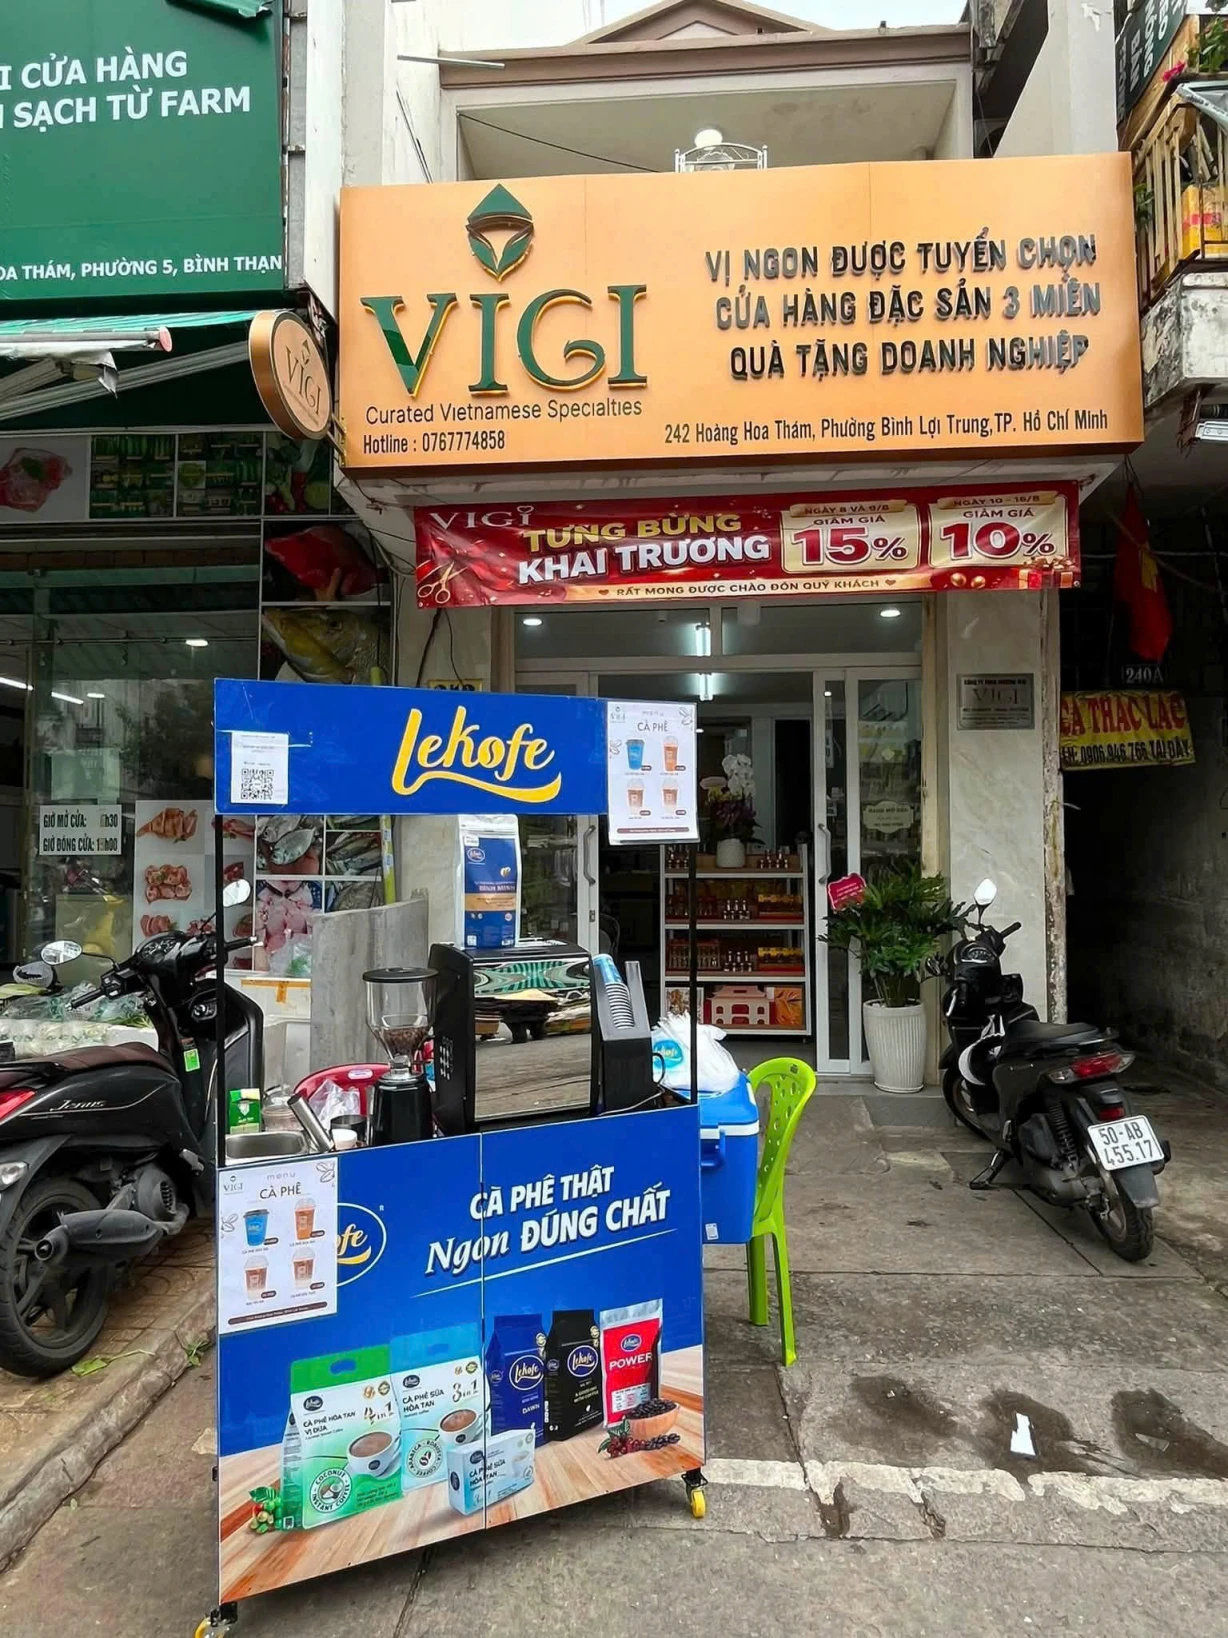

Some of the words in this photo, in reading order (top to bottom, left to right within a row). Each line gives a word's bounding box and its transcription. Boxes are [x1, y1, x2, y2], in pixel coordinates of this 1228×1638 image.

[21, 52, 87, 90] CỬA
[96, 46, 188, 83] HÀNG
[13, 97, 97, 132] SẠCH
[106, 86, 153, 121] TỪ
[161, 86, 251, 117] FARM
[22, 261, 77, 281] THÁM,
[81, 257, 157, 277] PHƯỜNG
[162, 259, 178, 277] 5,
[183, 253, 230, 274] BÌNH
[234, 255, 283, 275] THẠN
[705, 251, 731, 286] VỊ
[743, 246, 819, 281] NGON
[832, 240, 906, 281] ĐƯỢC
[917, 226, 1006, 273] TUYỂN
[1019, 234, 1096, 275] CHỌN
[716, 284, 770, 330] CỬA
[783, 288, 856, 327] HÀNG
[869, 285, 924, 327] ĐẶC
[936, 278, 991, 320] SẢN
[1003, 286, 1020, 319] 3
[1031, 273, 1100, 317] MIỀN
[360, 285, 648, 397] VIGI
[730, 340, 785, 380] QUÀ
[796, 338, 868, 382] TẶNG
[881, 338, 975, 375] DOANH
[987, 329, 1089, 375] NGHIỆP
[285, 345, 322, 416] VIGI
[366, 404, 434, 425] Curated
[440, 402, 542, 421] Vietnamese
[547, 398, 643, 421] Specialties
[665, 423, 690, 444] 242
[696, 421, 738, 445] Hoàng
[744, 421, 769, 441] Hoa
[775, 418, 816, 441] Thám,
[821, 416, 875, 440] Phường
[882, 416, 912, 437] Bình
[920, 415, 941, 438] Lợi
[1023, 410, 1041, 432] Hồ
[1047, 408, 1068, 431] Chí
[1074, 408, 1108, 430] Minh
[363, 433, 409, 454] Hotline
[422, 430, 506, 451] 0767774858
[805, 505, 836, 515] NGÀY
[850, 503, 866, 512] VÀ
[953, 497, 987, 507] NGÀY
[990, 497, 1003, 505] 10
[963, 508, 1003, 518] GIẢM
[1007, 507, 1034, 518] GIÁ
[429, 505, 532, 531] VIGI
[858, 515, 886, 524] GIÁ
[523, 523, 626, 552] TƯNG
[637, 512, 742, 540] BỪNG
[940, 521, 1056, 560] 10%
[518, 548, 607, 584] KHAI
[615, 534, 771, 571] TRƯƠNG
[792, 527, 909, 566] 15%
[617, 586, 641, 596] RẤT
[645, 586, 685, 595] MONG
[689, 583, 725, 595] ĐƯỢC
[729, 582, 766, 593] CHÀO
[770, 580, 799, 591] ĐÓN
[803, 579, 831, 590] QUÝ
[834, 578, 879, 589] KHÁCH
[1126, 667, 1163, 683] 240A
[637, 720, 650, 732] CÀ
[652, 721, 669, 732] PHÊ
[392, 706, 562, 803] Lekofe
[43, 811, 56, 828] GIỜ
[57, 809, 69, 828] MỞ
[70, 809, 87, 828] CỬA:
[43, 834, 55, 852] GIỜ
[56, 835, 76, 852] ĐÓNG
[78, 833, 95, 852] CỬA:
[97, 838, 118, 852] 1h00
[1104, 1139, 1153, 1166] 455.17
[223, 1182, 243, 1192] VIGI
[267, 1172, 296, 1181] menu
[259, 1185, 277, 1200] CÀ
[280, 1182, 301, 1198] PHÊ
[469, 1186, 504, 1221] CÀ
[510, 1173, 556, 1213] PHÊ
[560, 1164, 615, 1201] THẬT
[425, 1230, 510, 1275] Ngon
[520, 1206, 598, 1252] ĐÚNG
[605, 1182, 671, 1231] CHẤT
[609, 1353, 653, 1371] POWER
[402, 1395, 414, 1405] CÀ
[430, 1388, 445, 1399] SỮA
[452, 1381, 463, 1402] 3
[471, 1379, 480, 1394] 1
[303, 1418, 314, 1428] CÀ
[314, 1416, 327, 1426] PHÊ
[328, 1413, 342, 1422] HÒA
[343, 1410, 356, 1419] TAN
[403, 1402, 420, 1413] HÒA
[420, 1400, 435, 1410] TAN
[315, 1469, 346, 1485] COCONUT
